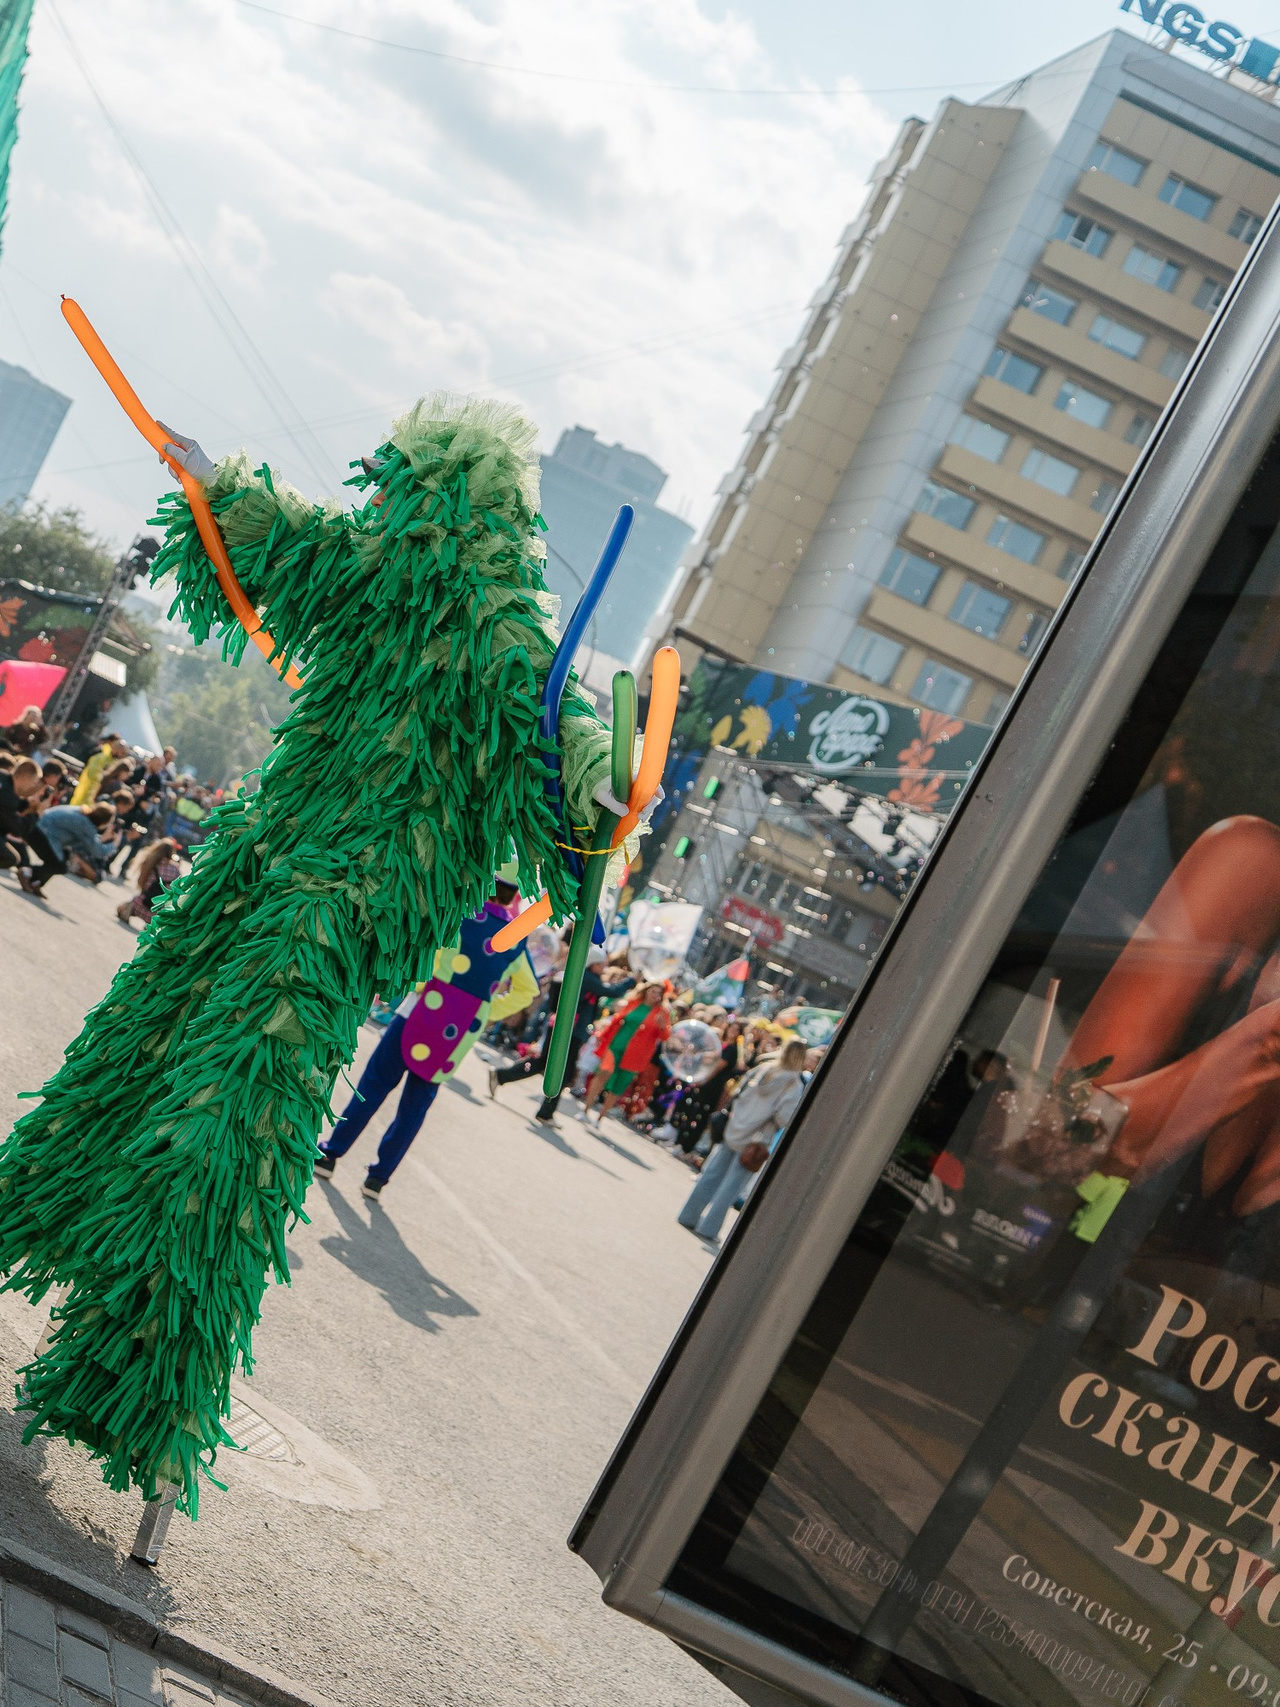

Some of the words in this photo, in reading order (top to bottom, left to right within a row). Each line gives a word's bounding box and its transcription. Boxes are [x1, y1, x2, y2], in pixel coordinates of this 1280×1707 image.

[1125, 1284, 1280, 1427] Рос
[792, 1516, 836, 1556] ООО
[920, 1580, 976, 1625] ОГРН
[1002, 1553, 1153, 1654] Советская,
[1162, 1632, 1205, 1669] 25
